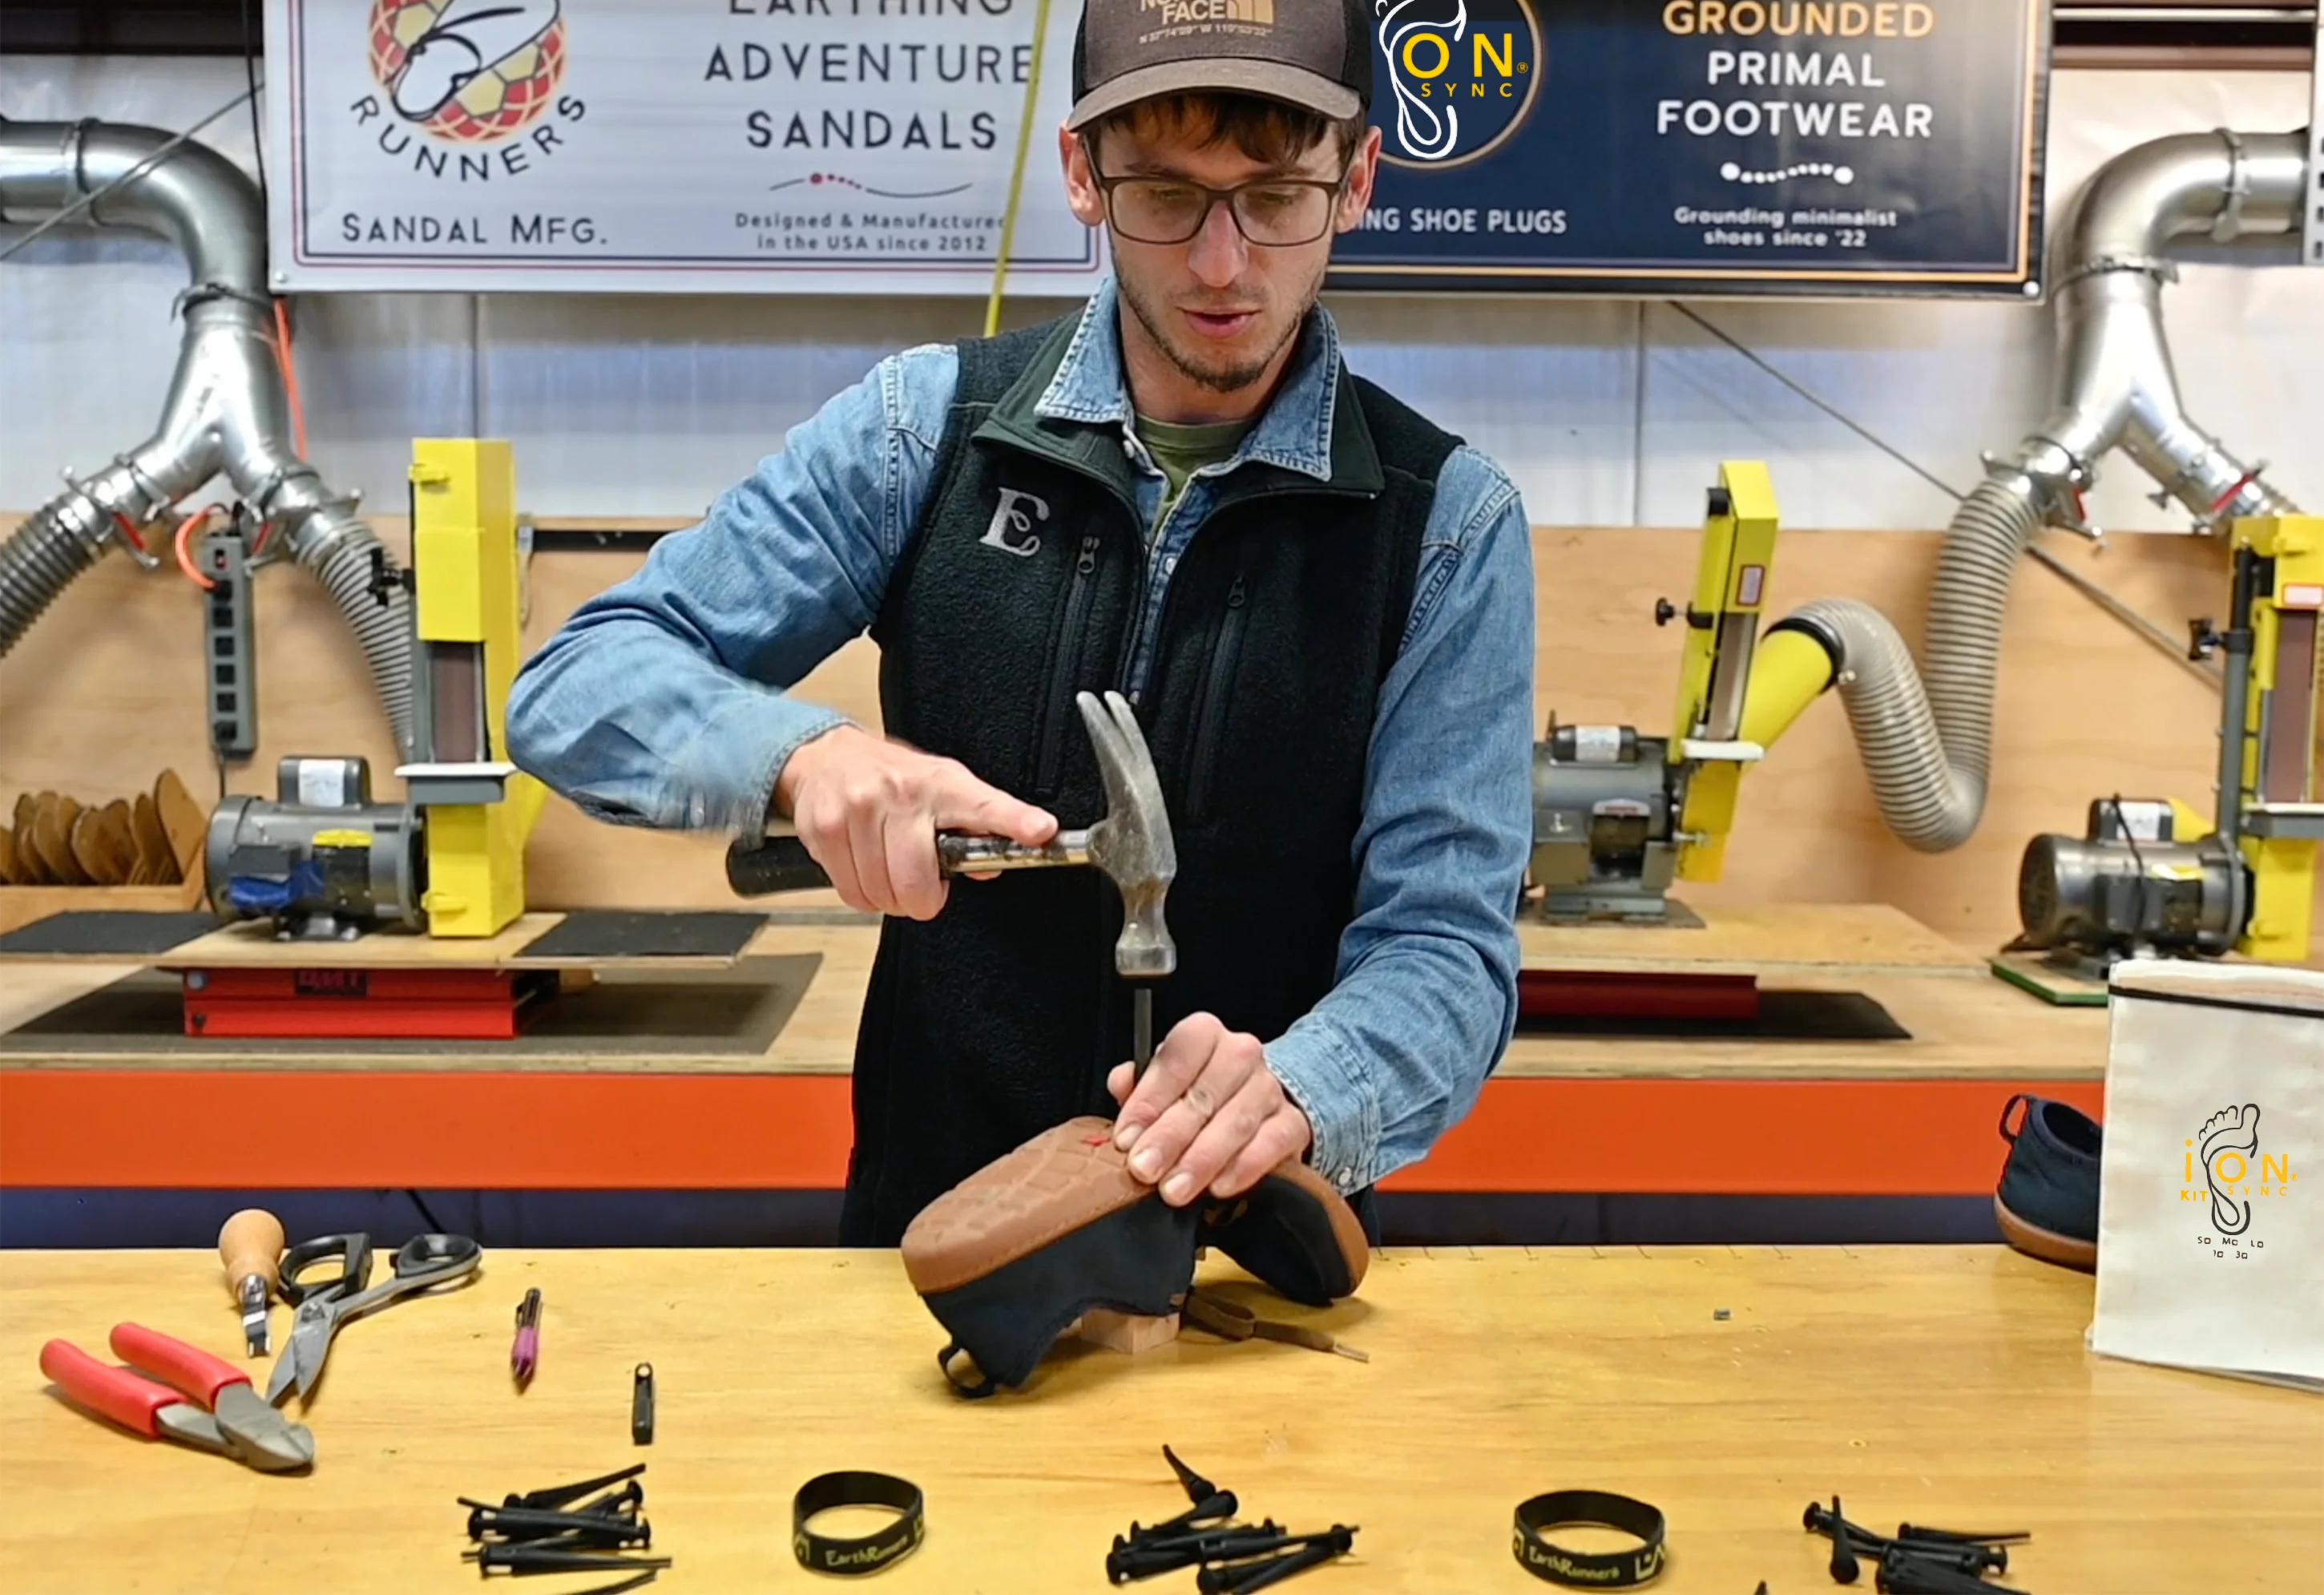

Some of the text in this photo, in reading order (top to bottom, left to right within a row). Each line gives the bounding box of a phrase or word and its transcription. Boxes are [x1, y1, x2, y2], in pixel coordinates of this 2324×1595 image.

[1163, 0, 1226, 25] FACE
[1662, 0, 1934, 38] GROUNDED
[704, 43, 1033, 83] ADVENTURE
[1708, 50, 1886, 87] PRIMAL
[1421, 83, 1513, 98] SYNC
[746, 111, 997, 150] SANDALS
[1656, 100, 1934, 138] FOOTWEAR
[350, 95, 586, 182] RUNNERS
[342, 213, 607, 244] SANDAL MFG.
[735, 212, 832, 230] Designed
[841, 212, 853, 228] &
[1358, 208, 1567, 233] ING SHOE PLUGS
[1674, 206, 1898, 228] Grounding minimalist
[758, 235, 986, 251] in the USA since 2012
[1704, 229, 1764, 246] shoes
[1772, 229, 1828, 247] since
[2181, 1190, 2208, 1201] KIT
[2227, 1185, 2288, 1196] SYNC
